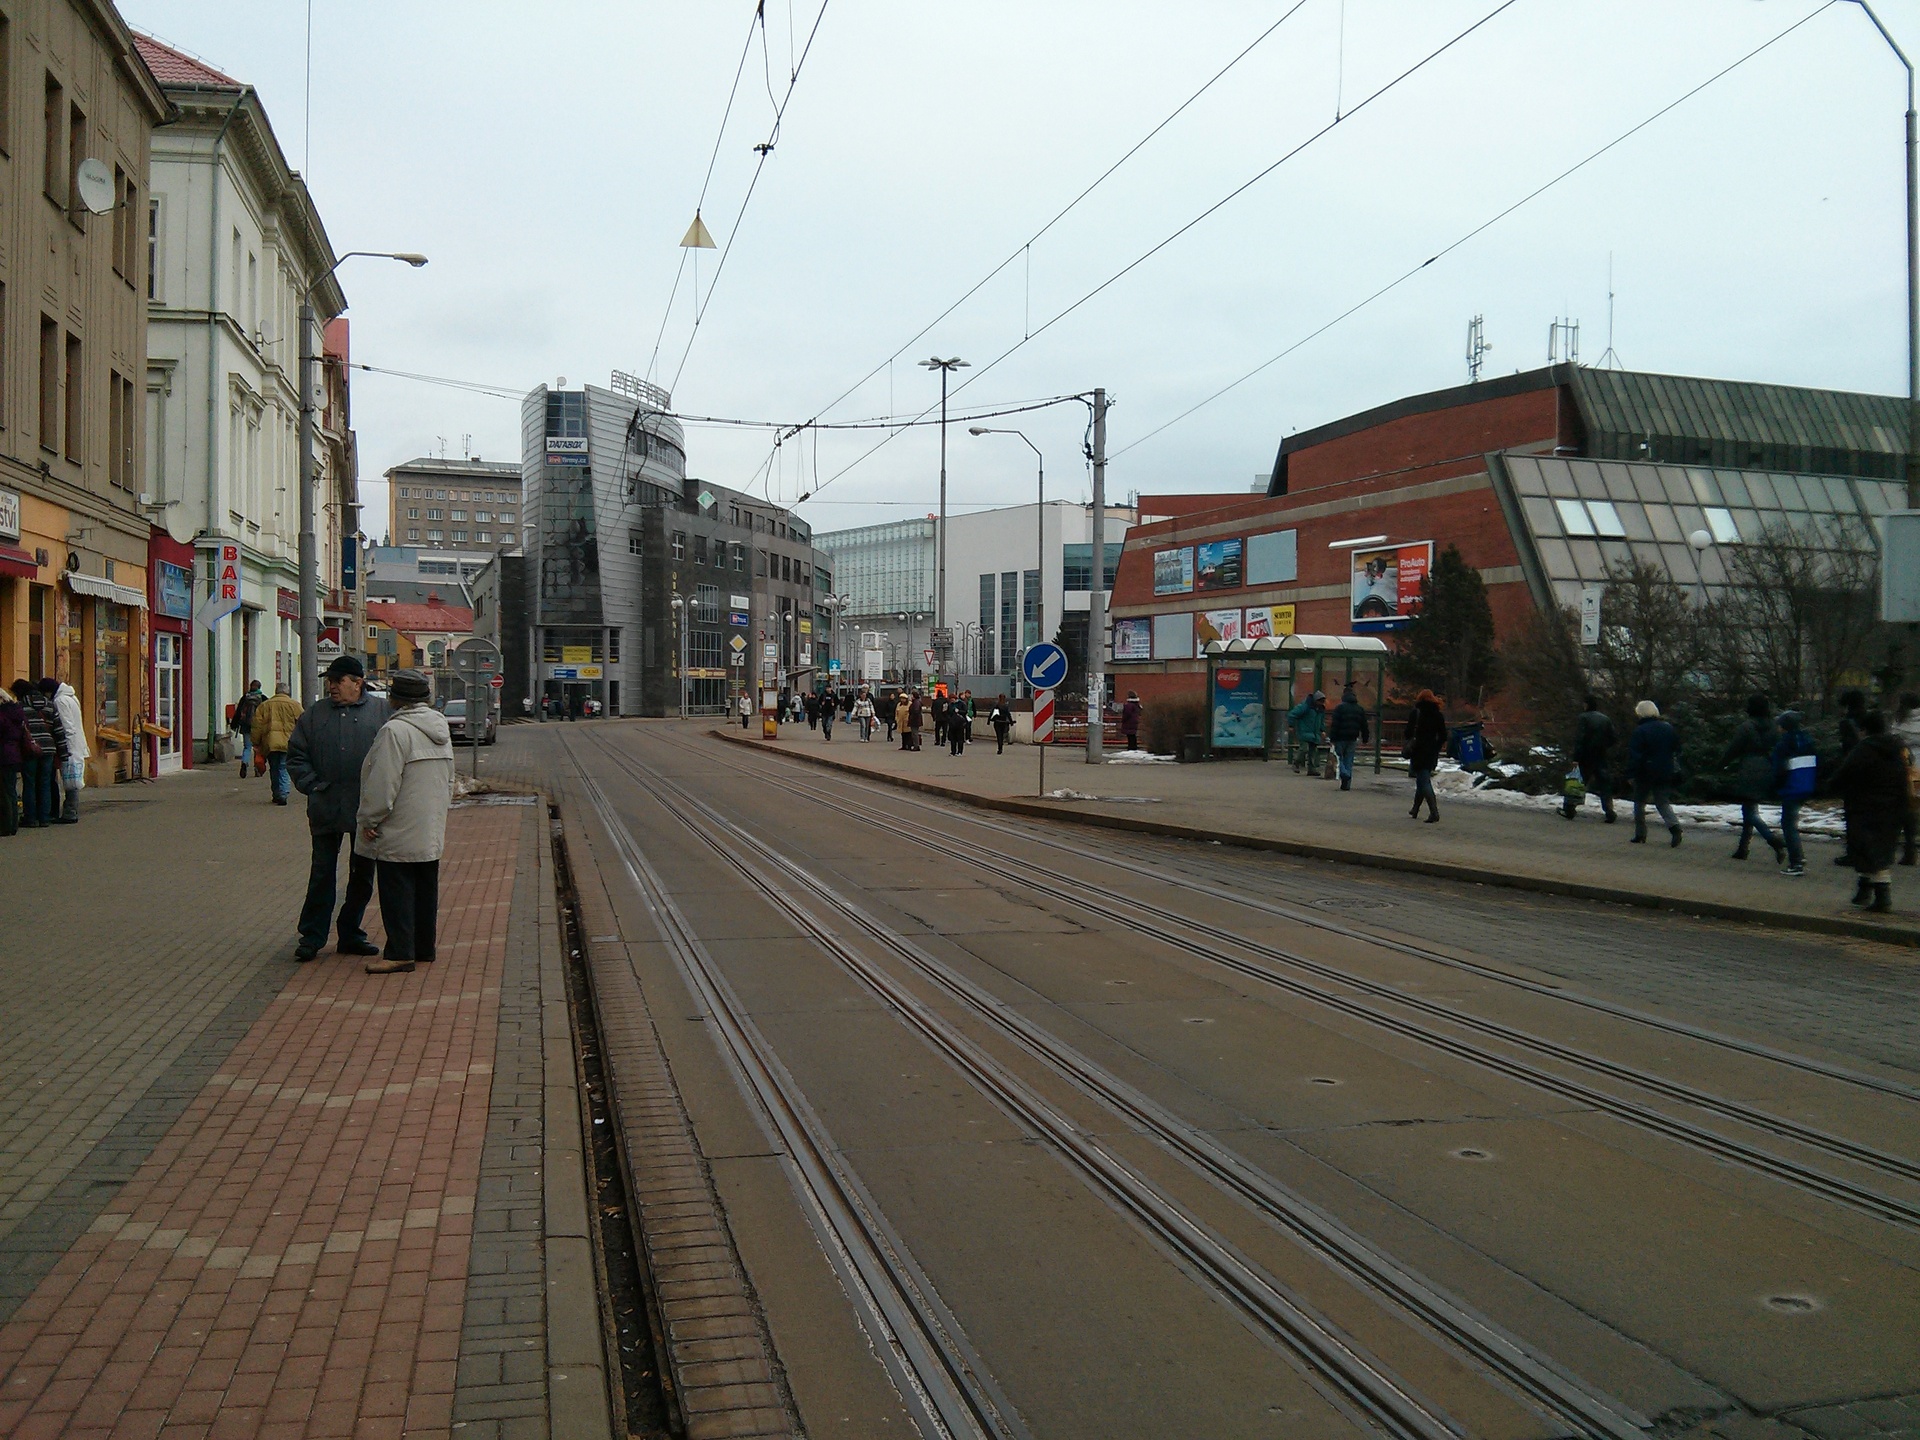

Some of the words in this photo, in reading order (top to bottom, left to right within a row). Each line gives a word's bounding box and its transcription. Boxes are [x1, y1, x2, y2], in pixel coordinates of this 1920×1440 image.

[548, 440, 584, 449] DATABOX
[1400, 557, 1425, 568] ProAuto
[222, 546, 238, 599] BAR
[317, 643, 340, 653] arlboro
